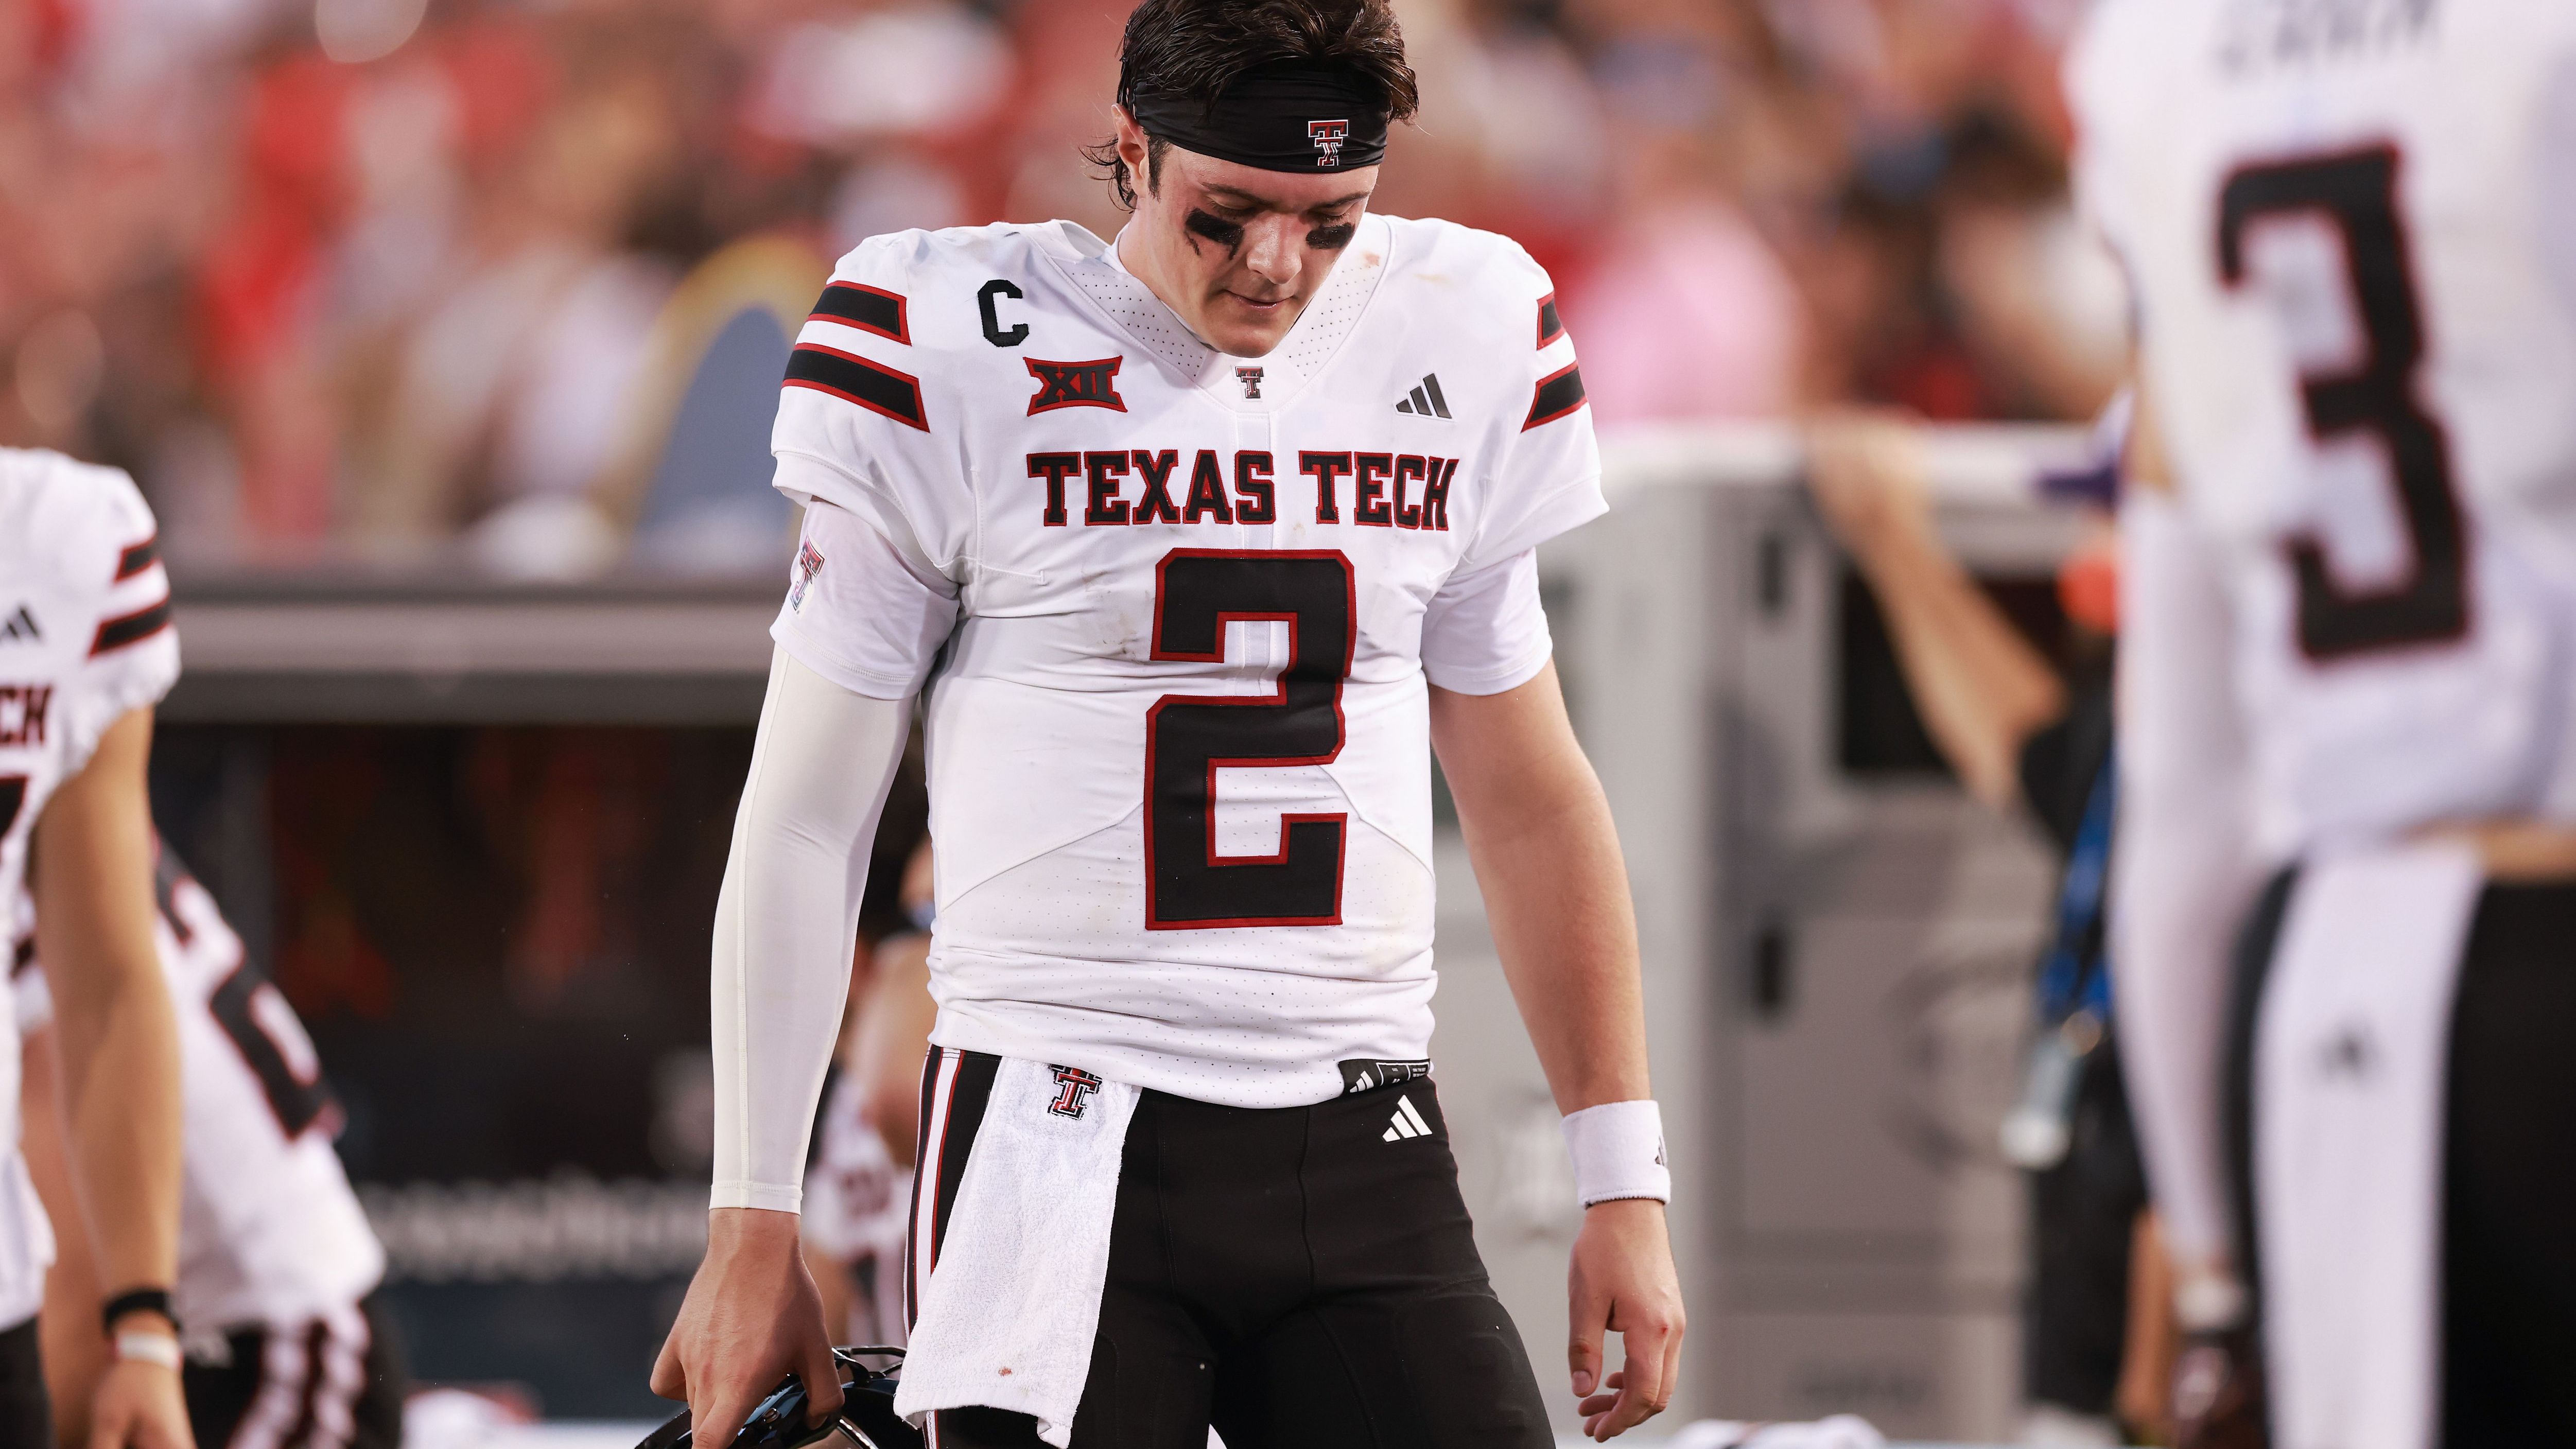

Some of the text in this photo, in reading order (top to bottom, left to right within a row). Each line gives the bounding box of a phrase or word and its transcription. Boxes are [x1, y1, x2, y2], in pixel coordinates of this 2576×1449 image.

[977, 280, 1029, 347] C
[2215, 138, 2472, 666] 3
[1026, 449, 1459, 531] TEXAS TECH
[1143, 547, 1357, 931] 2
